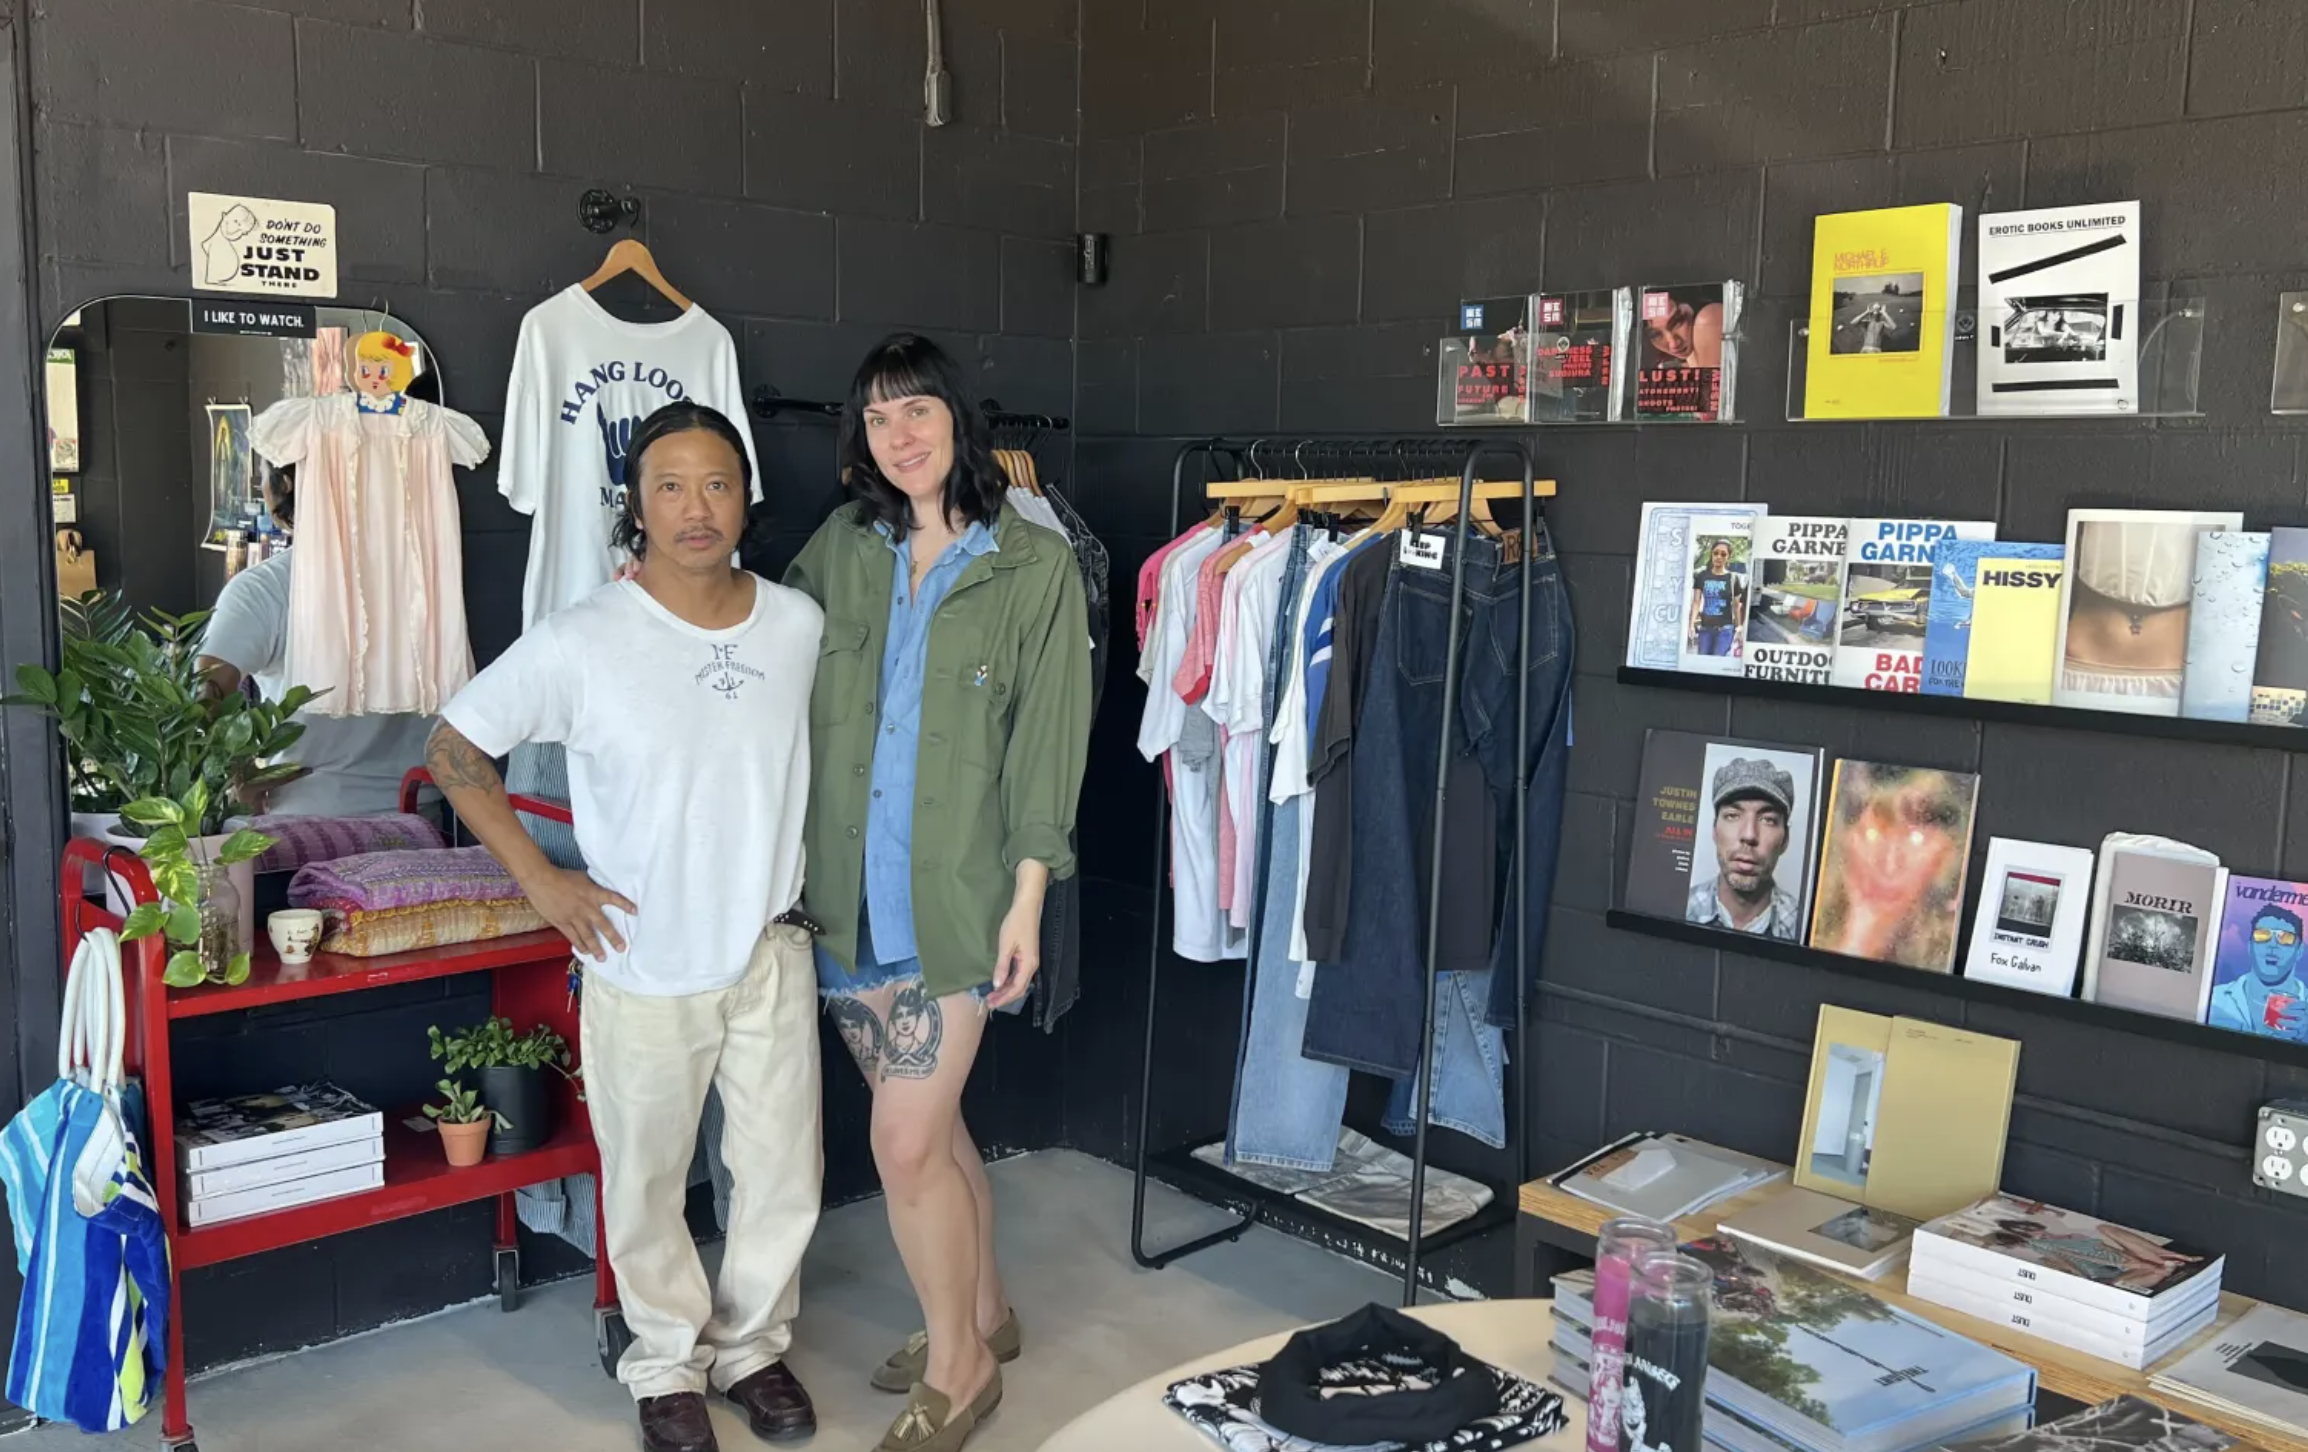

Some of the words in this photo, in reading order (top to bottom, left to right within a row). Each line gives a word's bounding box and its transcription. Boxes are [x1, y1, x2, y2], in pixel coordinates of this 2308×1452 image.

[304, 222, 321, 234] DO
[1989, 223, 2025, 235] EROTIC
[2027, 221, 2064, 233] BOOKS
[2066, 215, 2127, 229] UNLIMITED
[259, 233, 327, 248] SOMETHING
[243, 246, 305, 262] JUST
[241, 263, 320, 281] STAND
[204, 310, 209, 322] I
[212, 311, 235, 324] LIKE
[240, 312, 256, 325] TO
[259, 313, 305, 328] WATCH.
[1459, 365, 1510, 378] PAST
[1638, 368, 1700, 382] LUST!
[560, 361, 625, 425] HANG
[633, 362, 693, 403] LOO
[1458, 384, 1509, 394] FUTURE
[1710, 369, 1721, 411] NSFW
[1788, 522, 1848, 539] PIPPA
[1878, 522, 1958, 541] PIPPA
[1772, 538, 1846, 556] GARNE
[1861, 542, 1935, 563] GARN
[1982, 570, 2063, 588] HISSY
[1754, 648, 1832, 667] OUTDO
[1945, 679, 1960, 688] THE
[1660, 786, 1698, 798] JUSTIN
[1652, 797, 1696, 811] TOWNES
[1661, 811, 1695, 824] EARLE
[2124, 891, 2193, 914] MORIR
[1990, 953, 2008, 967] Fox
[2011, 956, 2042, 972] Galvan
